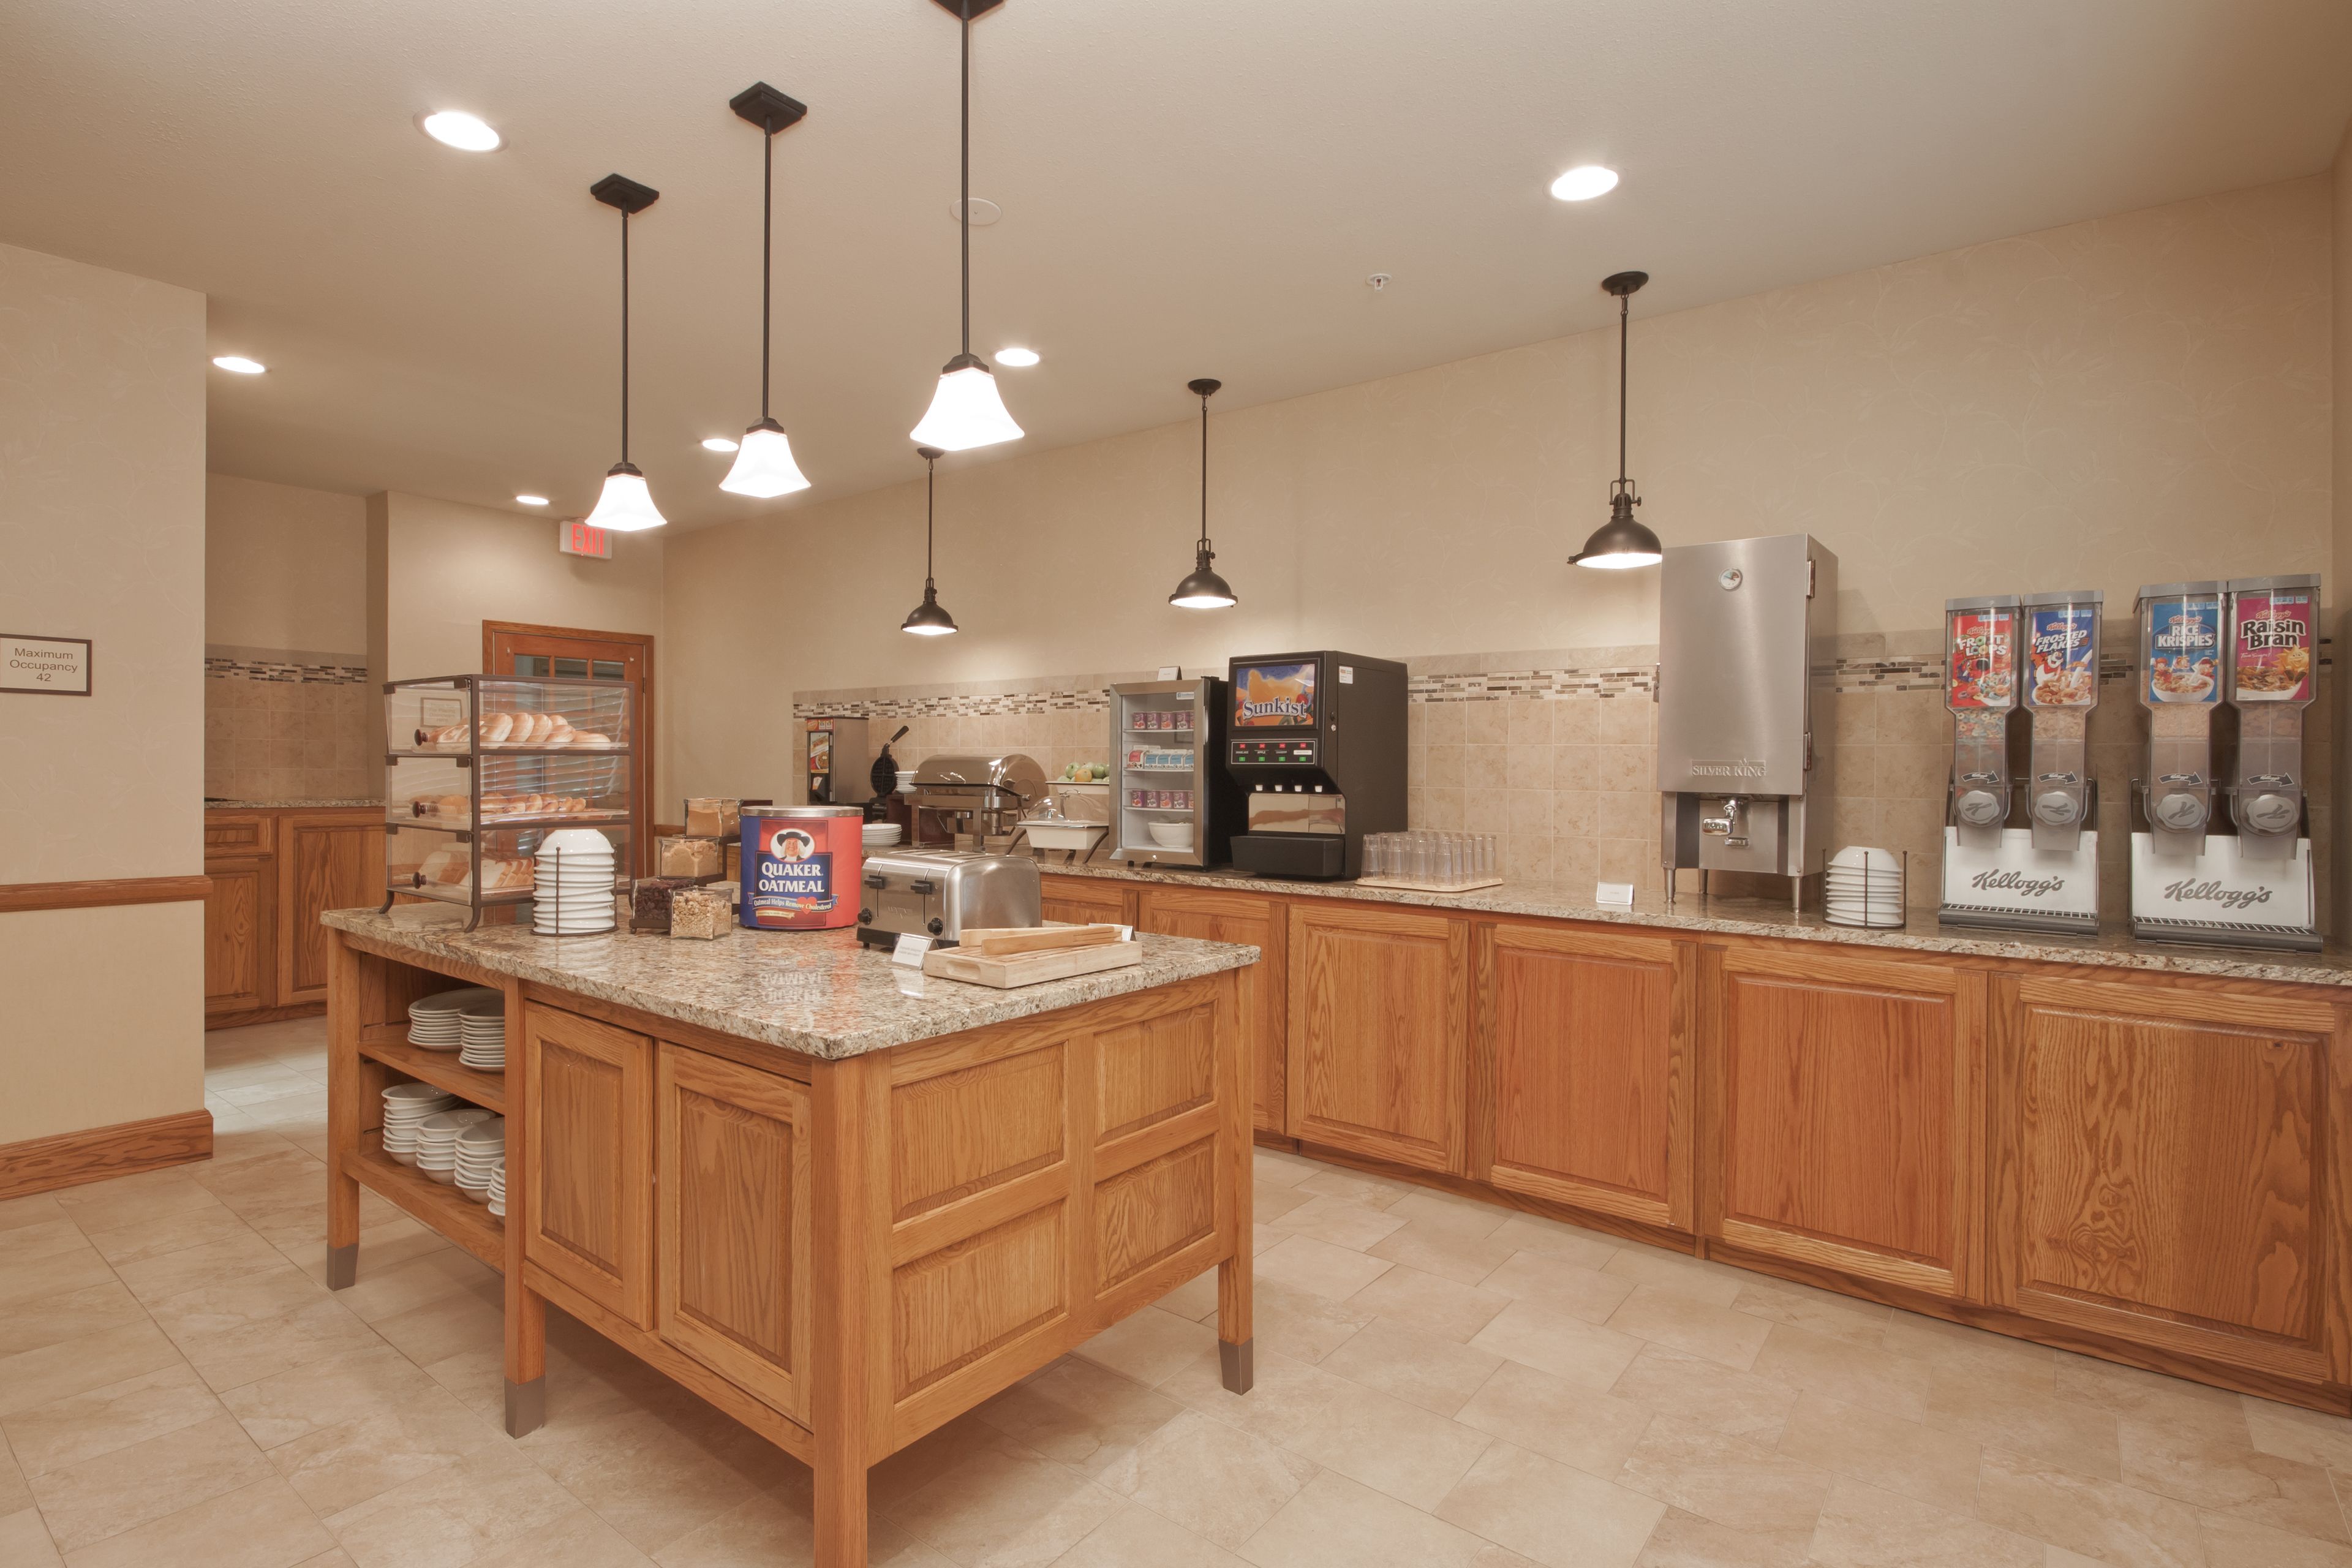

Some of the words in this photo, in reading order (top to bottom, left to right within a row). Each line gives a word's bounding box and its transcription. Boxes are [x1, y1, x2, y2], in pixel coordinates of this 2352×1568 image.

[572, 524, 606, 556] EXIT
[1967, 626, 1996, 635] Kellogg
[2172, 625, 2199, 636] RICE
[2241, 619, 2305, 638] Raisin
[2037, 639, 2081, 653] FLAKES
[2158, 634, 2213, 647] KRISPIES
[2248, 633, 2299, 650] Bran
[15, 648, 73, 659] Maximum
[1966, 644, 2007, 656] LOOPS
[10, 660, 78, 673] Occupancy
[1243, 696, 1308, 720] Sunkist
[1692, 766, 1730, 776] SILVER
[1733, 766, 1765, 777] KING
[762, 862, 821, 878] QUAKER
[758, 879, 824, 892] OATMEAL
[1972, 869, 2065, 897] Kellogg's
[2164, 878, 2273, 909] Kellogg's
[754, 898, 771, 907] Oatmeal
